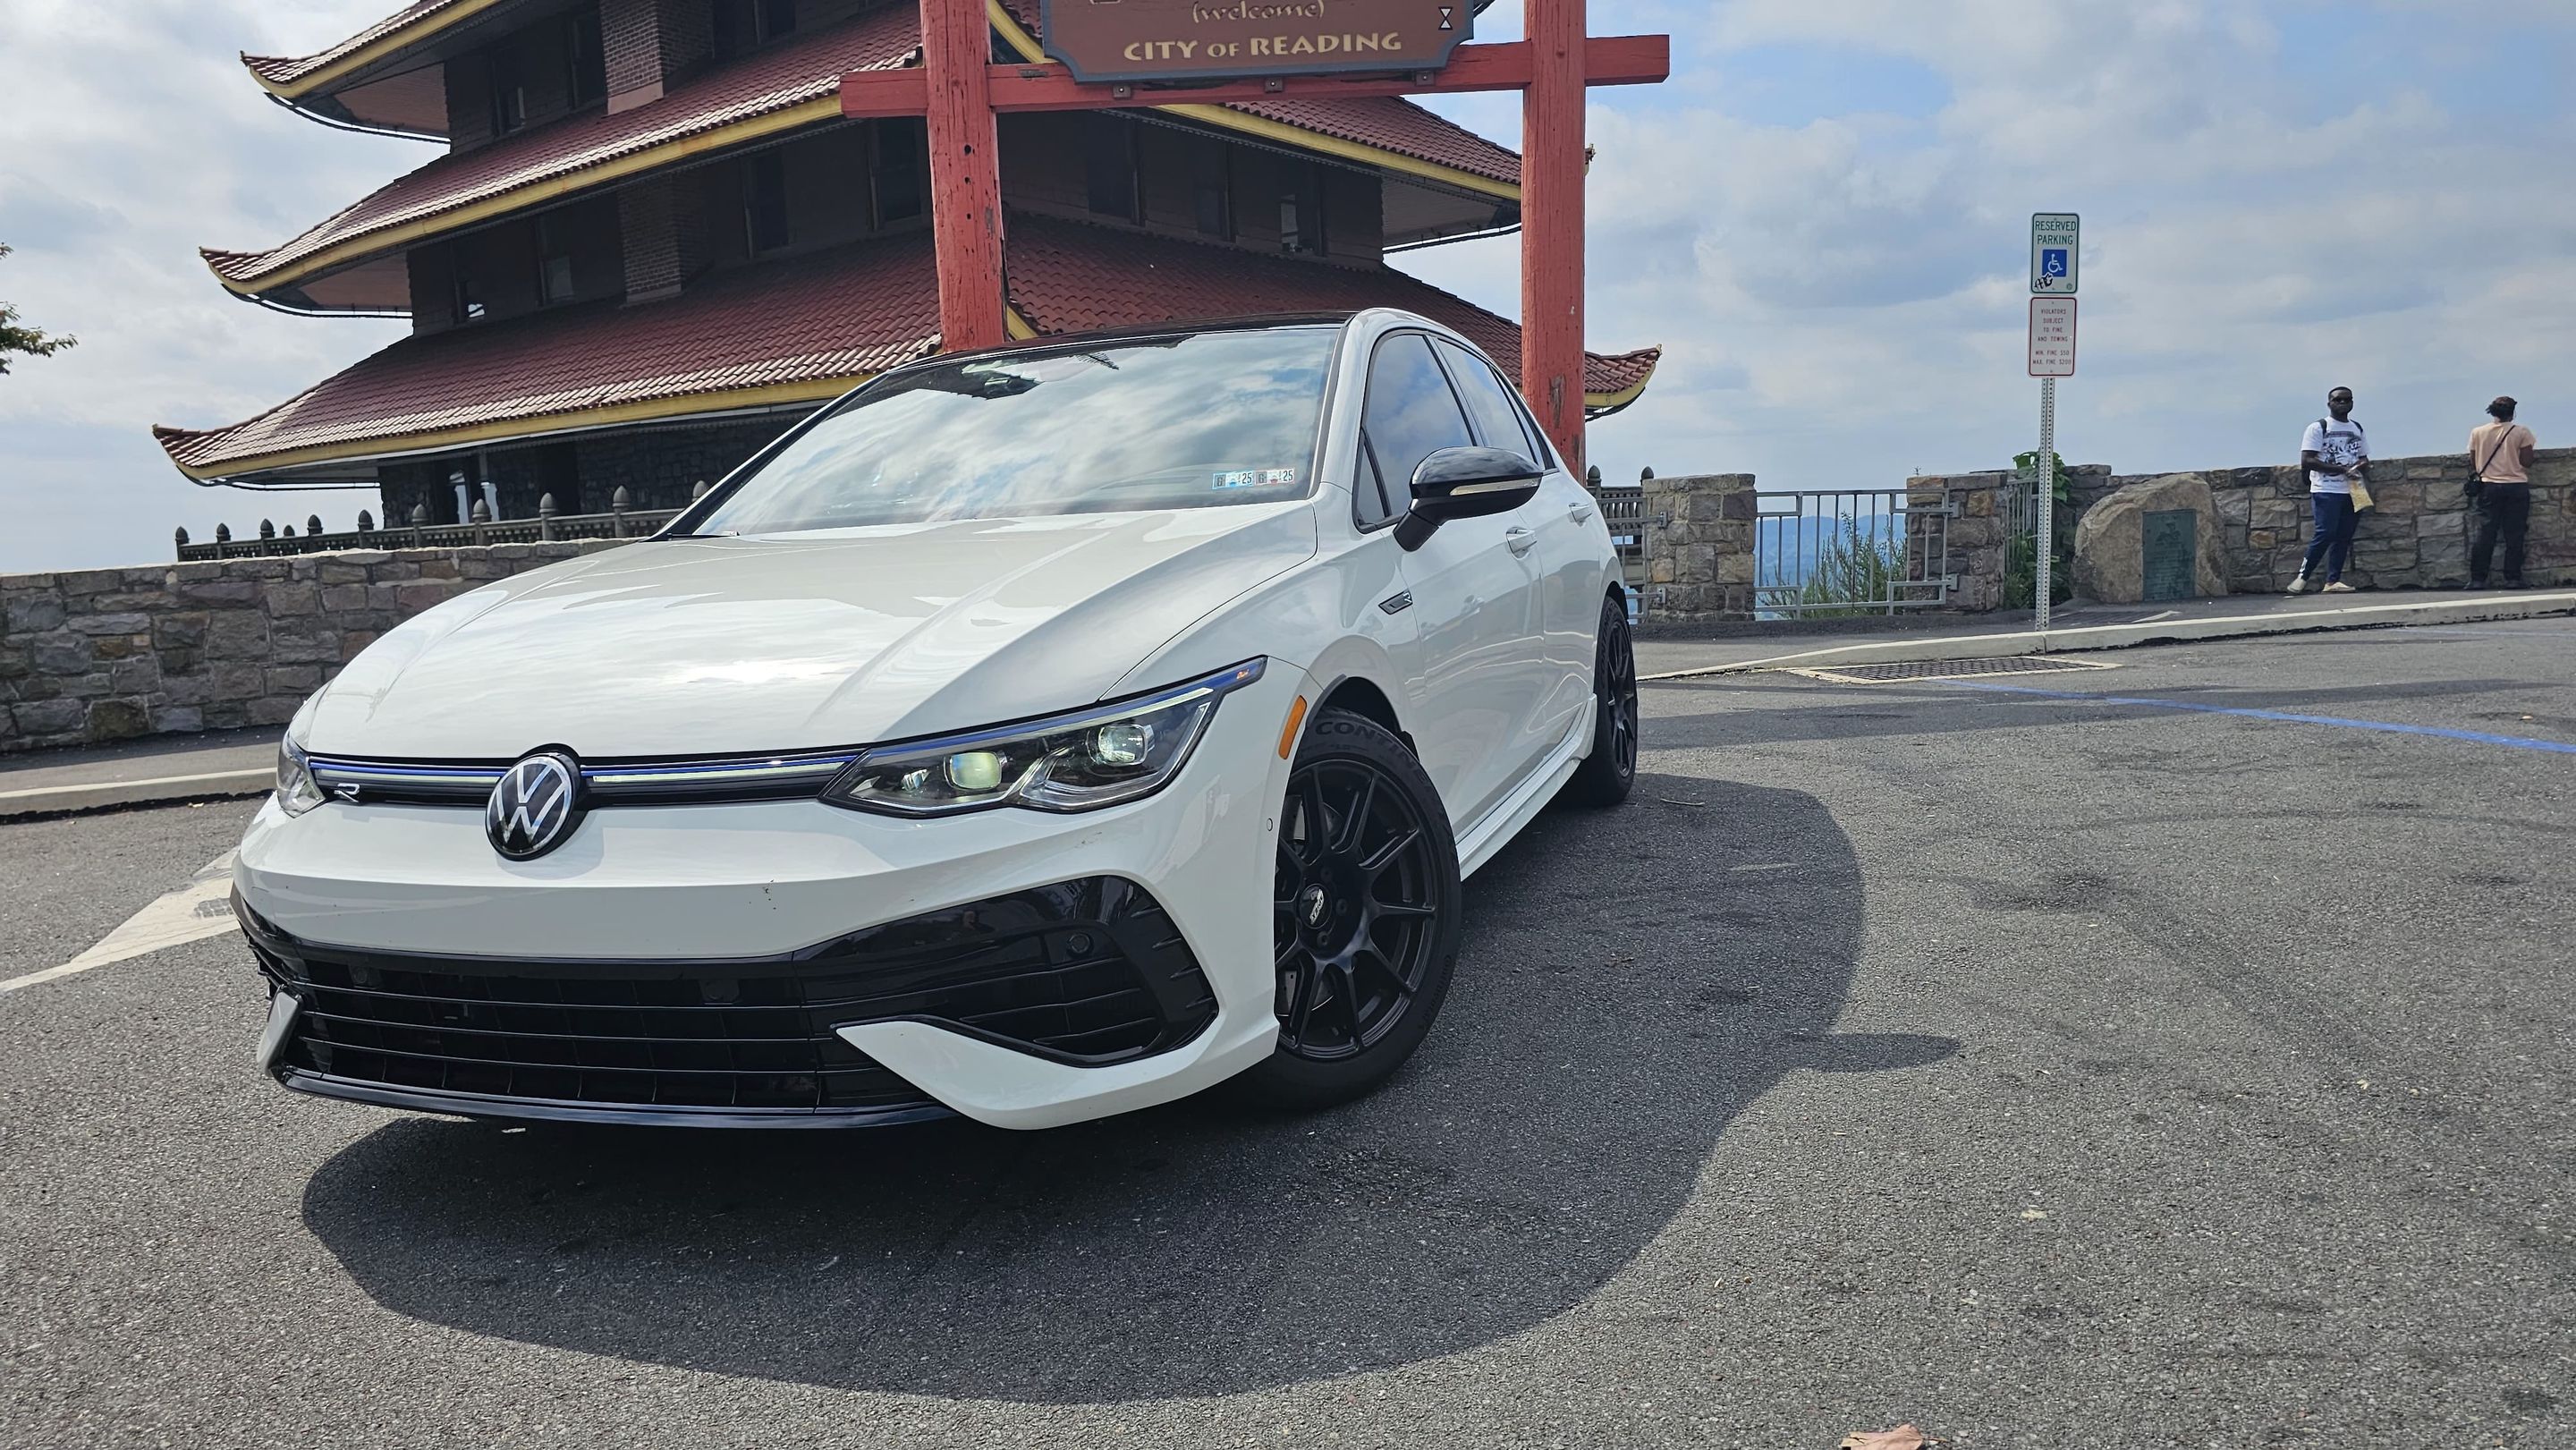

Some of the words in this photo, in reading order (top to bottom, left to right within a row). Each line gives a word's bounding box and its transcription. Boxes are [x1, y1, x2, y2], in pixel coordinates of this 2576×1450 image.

[1123, 39, 1199, 62] CITY
[1207, 42, 1241, 58] OF
[1250, 31, 1402, 56] READING
[2035, 220, 2077, 232] RESERVED
[2037, 234, 2073, 245] PARKING
[1241, 472, 1252, 484] 25
[1283, 470, 1293, 482] 25
